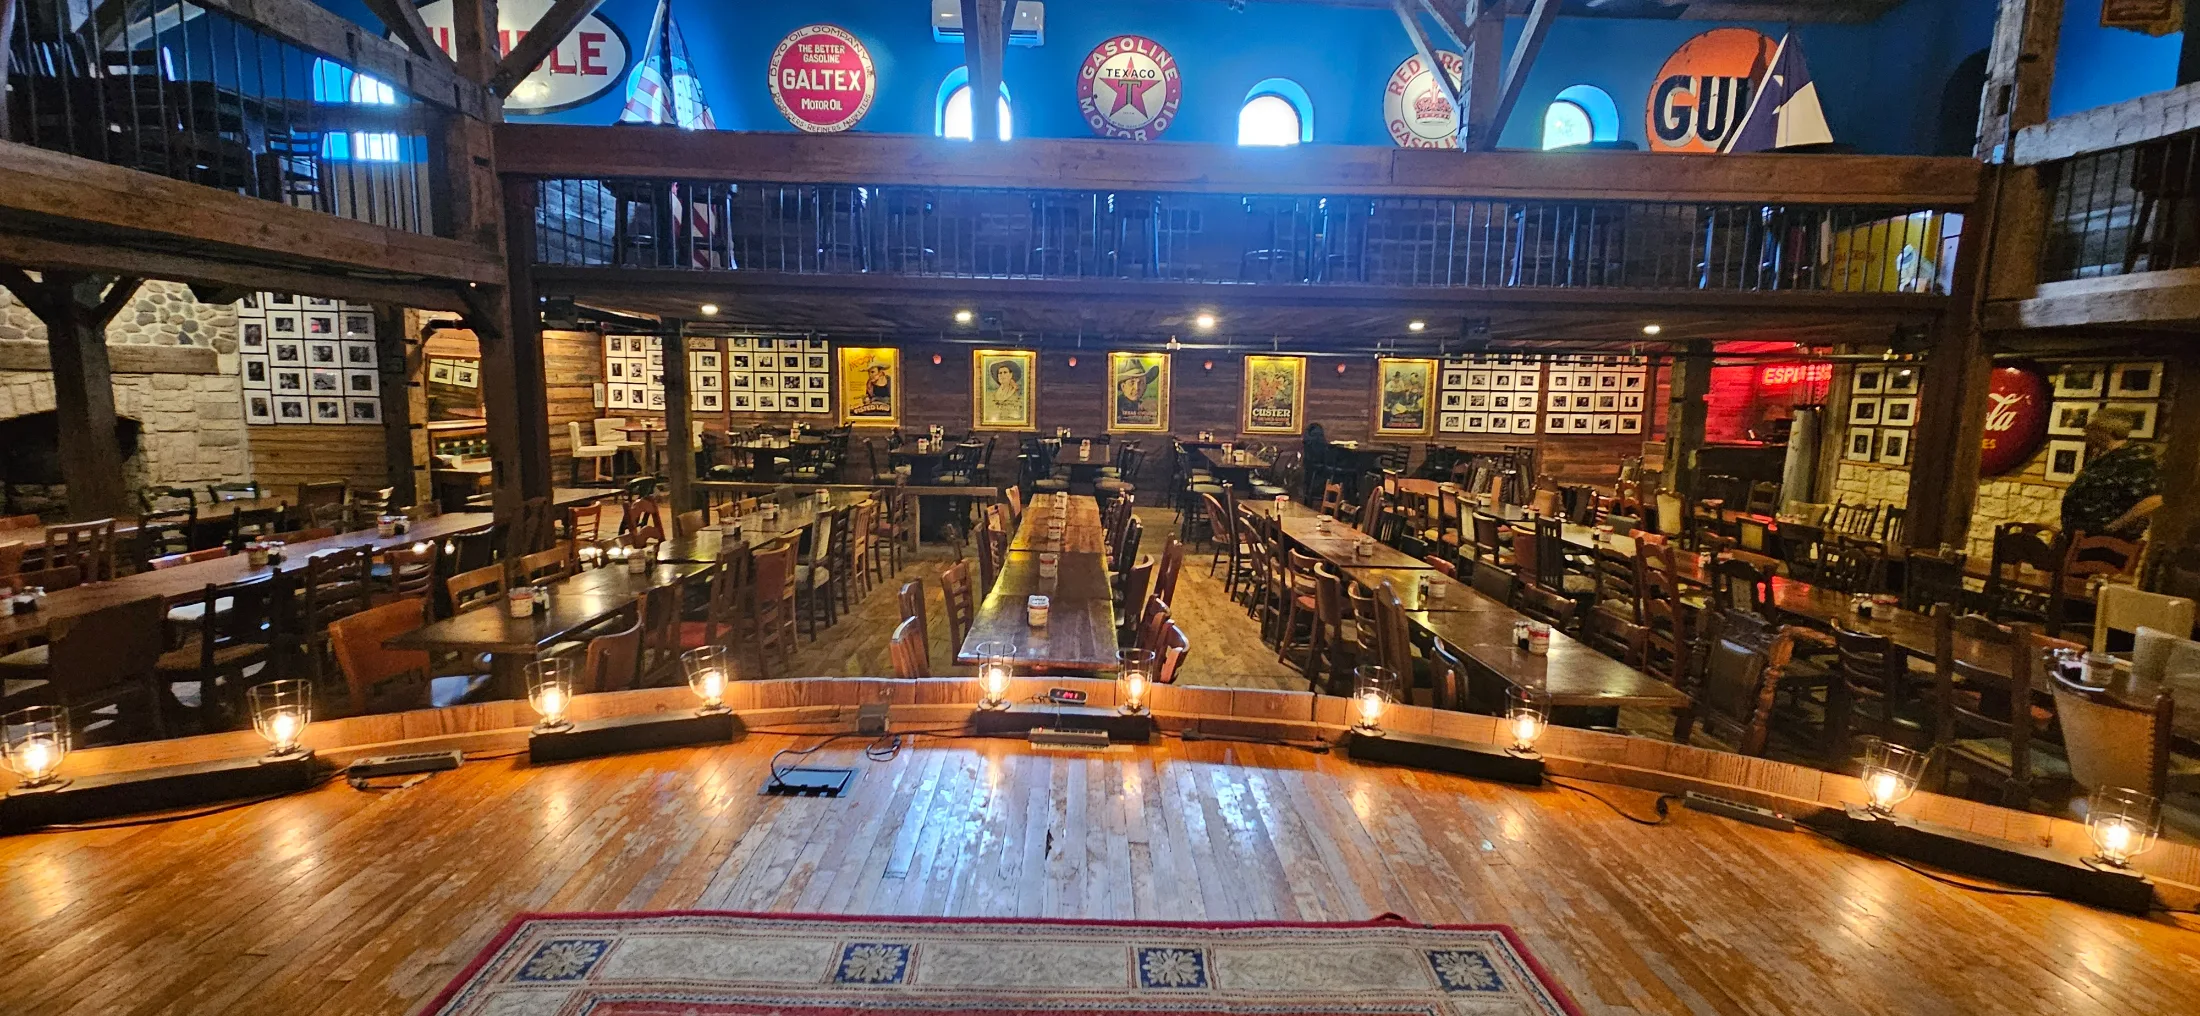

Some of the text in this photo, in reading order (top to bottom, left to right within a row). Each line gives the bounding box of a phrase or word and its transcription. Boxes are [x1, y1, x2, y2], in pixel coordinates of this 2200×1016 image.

[770, 42, 788, 77] DEYO
[789, 30, 808, 42] OIL
[811, 26, 869, 60] COMPANY
[798, 43, 845, 54] THE BETTER
[802, 54, 840, 64] GASOLINE
[1082, 37, 1179, 82] GASOLINE
[782, 68, 861, 91] GALTEX
[1105, 68, 1155, 79] TEXACO
[1388, 58, 1421, 96] RED
[773, 92, 804, 128] PRODUCERS
[843, 93, 872, 128] MARKETERS
[829, 99, 843, 111] OIL
[1153, 98, 1179, 132] OIL
[1252, 408, 1291, 417] CUSTER
